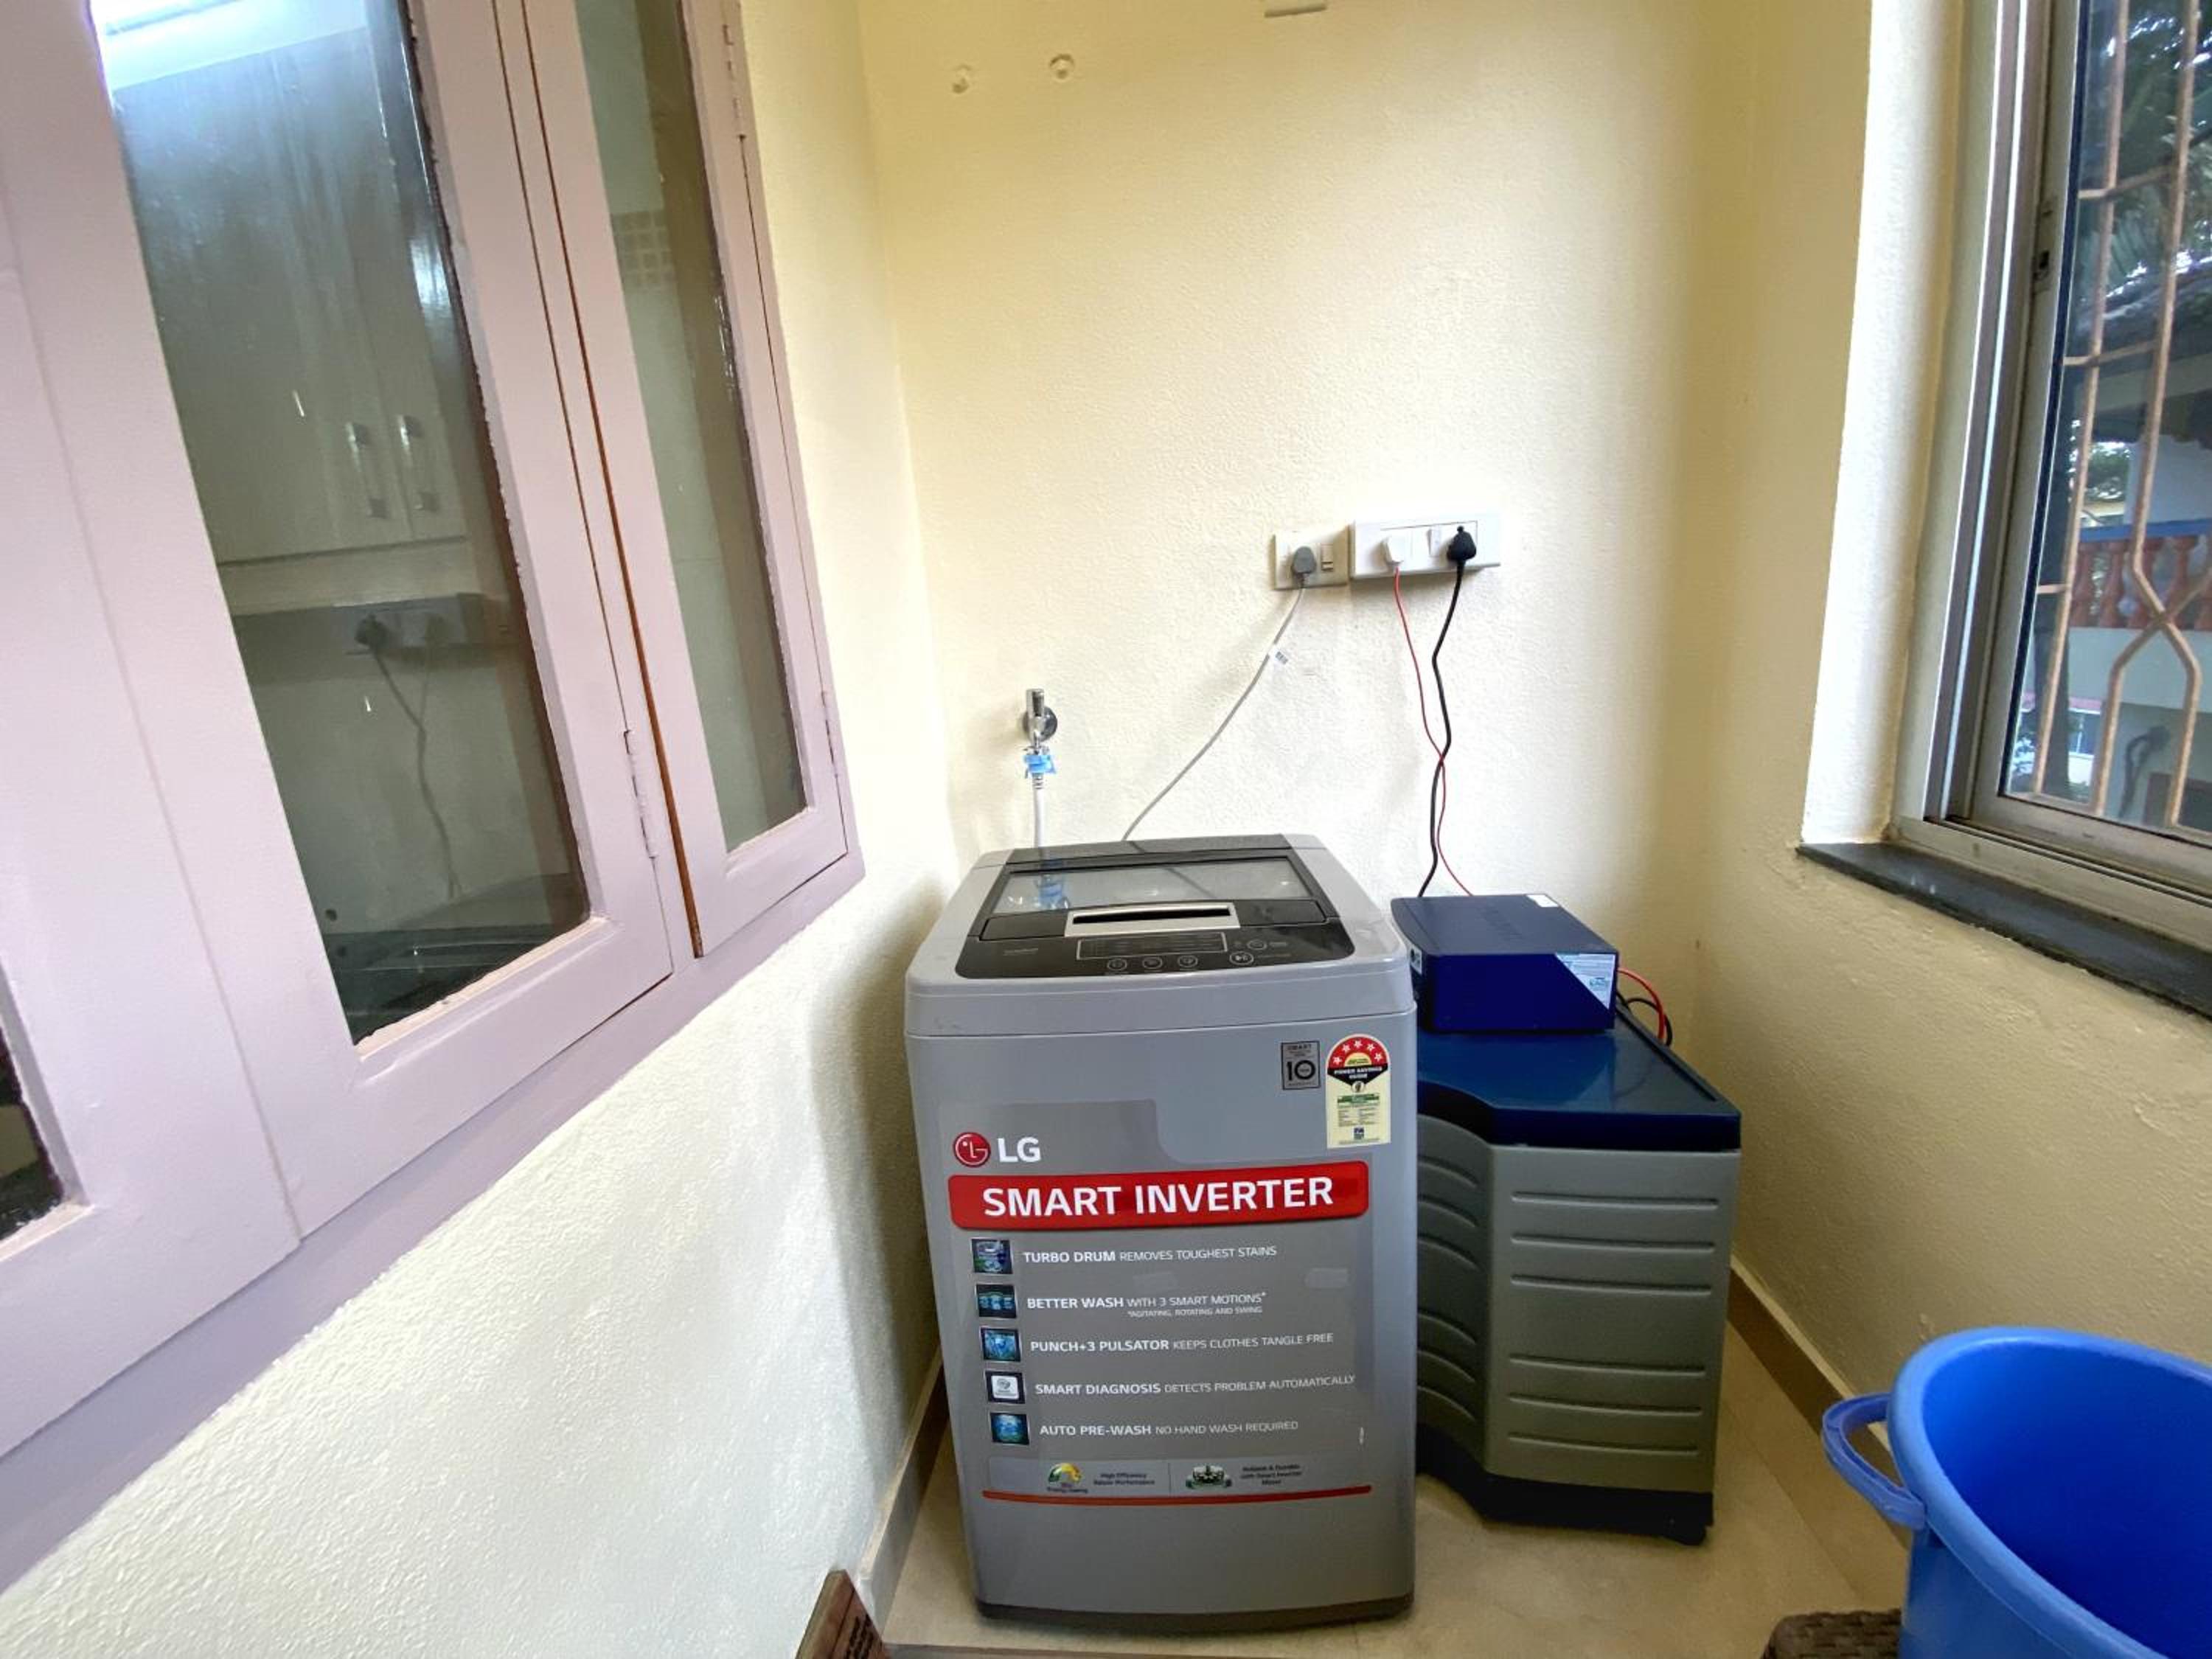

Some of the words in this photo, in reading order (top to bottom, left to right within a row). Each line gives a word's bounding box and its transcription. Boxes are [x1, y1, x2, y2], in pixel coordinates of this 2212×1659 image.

[998, 1136, 1041, 1163] LG
[983, 1186, 1121, 1217] SMART
[1135, 1176, 1334, 1214] INVERTER
[1023, 1251, 1069, 1263] TURBO
[1074, 1251, 1116, 1262] DRUM
[1120, 1251, 1173, 1262] REMOVES
[1176, 1248, 1234, 1260] TOUGHEST
[1238, 1246, 1277, 1257] STAINS
[1027, 1298, 1077, 1309] BETTER
[1081, 1297, 1124, 1308] WASH
[1127, 1297, 1156, 1307] WITH
[1160, 1297, 1166, 1307] 3
[1169, 1295, 1207, 1307] SMART
[1031, 1341, 1095, 1352] PUNCH+3
[1099, 1340, 1169, 1352] PULSATOR
[1172, 1339, 1207, 1350] KEEPS
[1210, 1337, 1259, 1349] CLOTHES
[1261, 1335, 1303, 1346] TANGLE
[1306, 1332, 1333, 1343] FREE
[1035, 1384, 1082, 1395] SMART
[1086, 1383, 1161, 1395] DIAGNOSIS
[1164, 1382, 1211, 1394] DETECTS
[1214, 1380, 1266, 1392] PROBLEM
[1268, 1374, 1355, 1390] AUTOMATICALLY
[1040, 1425, 1076, 1436] AUTO
[1080, 1425, 1152, 1436] PRE-WASH
[1155, 1425, 1172, 1435] NO
[1175, 1424, 1206, 1435] HAND
[1209, 1422, 1243, 1433] WASH
[1245, 1421, 1298, 1433] REQUIRED
